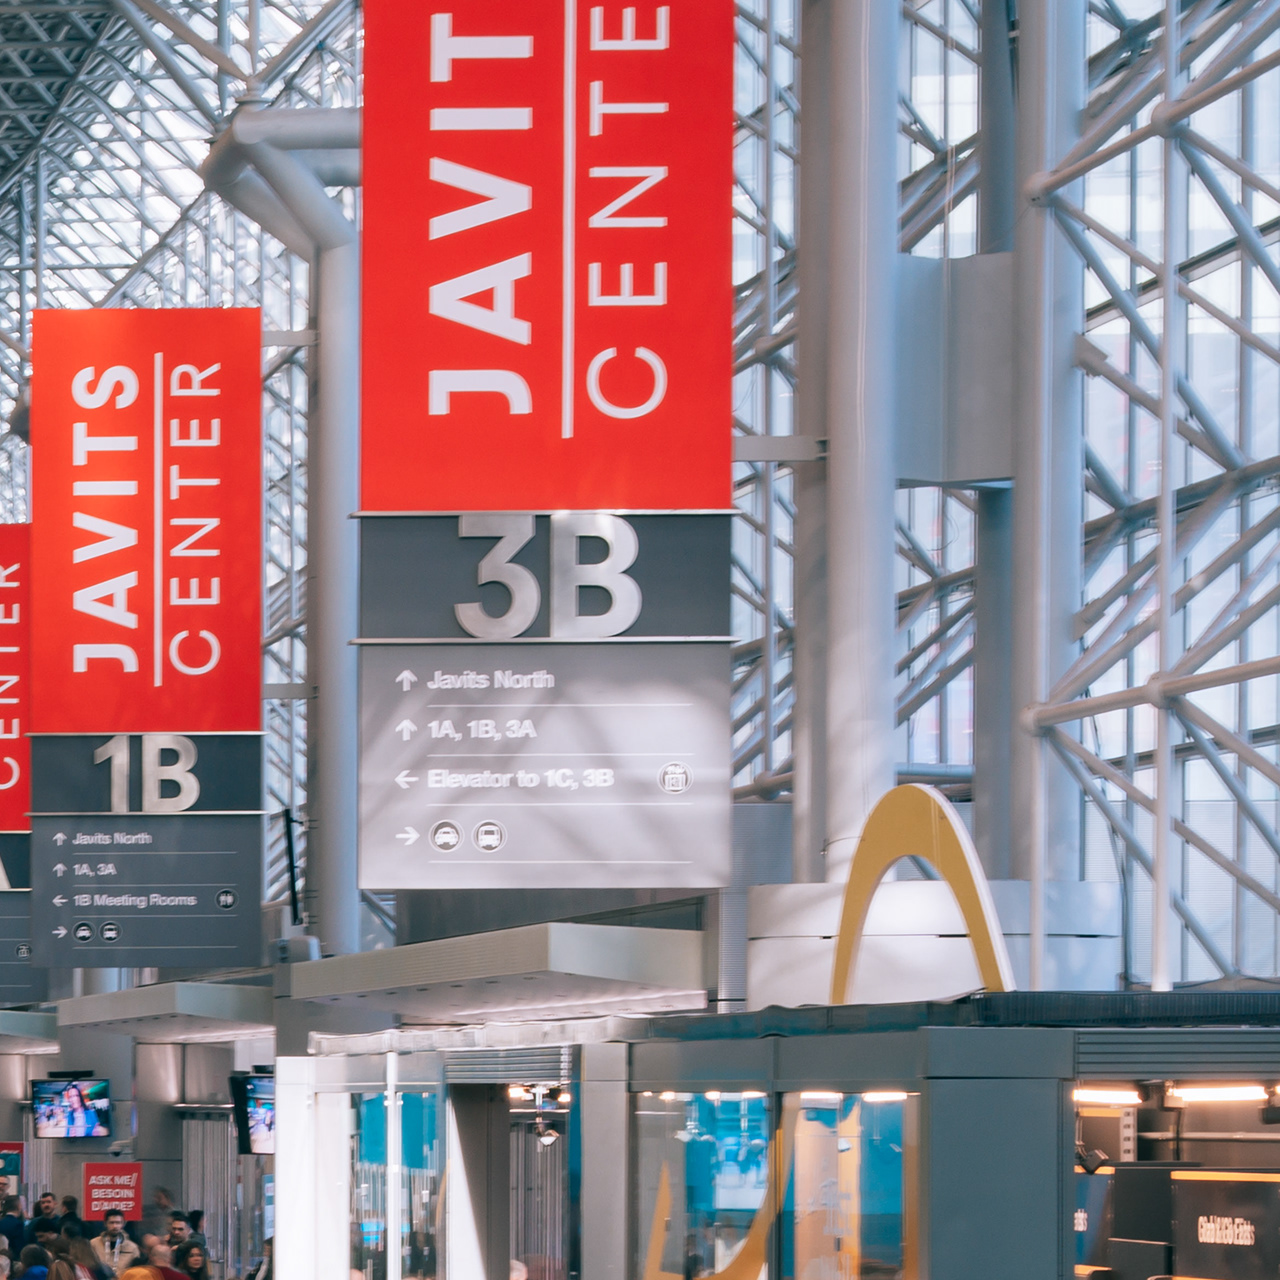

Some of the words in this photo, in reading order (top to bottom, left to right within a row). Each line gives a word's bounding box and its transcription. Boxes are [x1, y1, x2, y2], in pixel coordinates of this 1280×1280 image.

[71, 364, 140, 673] JAVITS
[168, 361, 222, 676] CENTER
[453, 512, 643, 640] 3B
[426, 670, 491, 690] Javits
[493, 669, 556, 690] North
[426, 719, 464, 742] 1A,
[466, 719, 503, 742] 1B,
[505, 718, 538, 739] 3A
[93, 734, 201, 813] 1B
[426, 769, 514, 789] Elevator
[516, 770, 540, 788] to
[543, 768, 579, 791] 1C,
[582, 767, 615, 788] 3B
[72, 832, 113, 845] Javits
[113, 831, 153, 845] North
[96, 863, 118, 876] 3A
[72, 894, 92, 906] 1B
[93, 894, 148, 909] Meeting
[148, 893, 198, 906] Rooms
[88, 1174, 113, 1186] ASK
[91, 1188, 135, 1199] BESOIN
